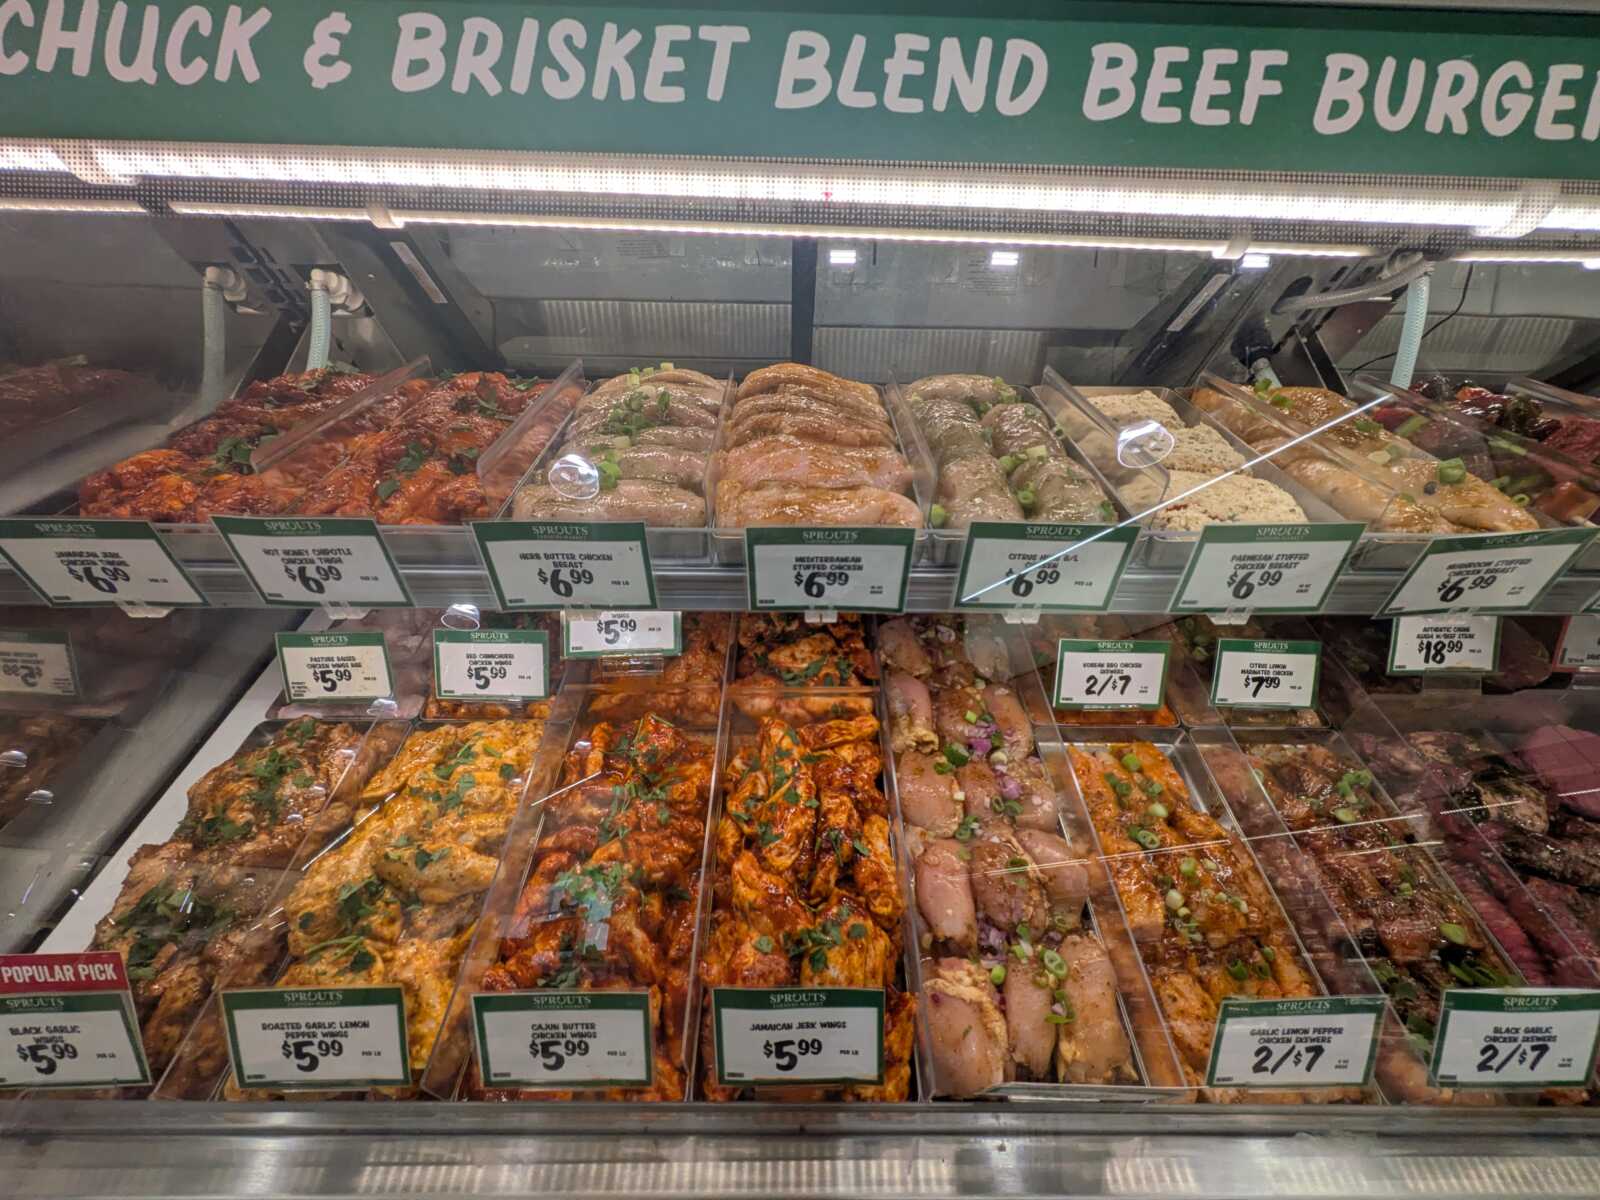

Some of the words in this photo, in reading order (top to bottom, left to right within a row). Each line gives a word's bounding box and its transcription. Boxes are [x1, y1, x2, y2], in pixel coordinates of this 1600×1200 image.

[0, 0, 273, 86] CHUCK
[303, 11, 352, 89] &
[391, 11, 750, 103] BRISKET
[774, 29, 1049, 117] BLEND
[1081, 41, 1290, 126] BEEF
[1311, 52, 1600, 143] BURGE
[263, 521, 321, 531] SPROUTS
[531, 525, 588, 536] SPROUTS
[802, 530, 858, 541] SPROUTS
[1025, 526, 1082, 537] SPROUTS
[1256, 527, 1311, 537] SPROUTS
[262, 548, 280, 556] HOT
[282, 548, 310, 556] HONEY
[311, 548, 352, 556] CHIPOTLE
[1008, 552, 1037, 561] CITRUS
[281, 557, 315, 565] CHICKEN
[519, 553, 542, 561] HERB
[543, 553, 577, 561] BUTTER
[578, 553, 613, 561] CHICKEN
[1230, 554, 1274, 562] PARMESAN
[1275, 553, 1310, 561] STUFFED
[552, 561, 584, 569] BREAST
[1233, 562, 1266, 570] CHICKEN
[1448, 568, 1482, 577] CHICKEN
[1483, 567, 1517, 575] BREAST
[470, 632, 509, 640] SPROUTS
[1097, 641, 1134, 649] SPROUTS
[1253, 641, 1288, 649] SPROUTS
[1085, 674, 1132, 696] 2/$7
[1, 964, 75, 983] POPULAR
[78, 963, 117, 981] PICK
[284, 991, 343, 1001] SPROUTS
[533, 996, 591, 1005] SPROUTS
[770, 993, 826, 1003] SPROUTS
[6, 999, 65, 1008] SPROUTS
[1276, 1001, 1330, 1010] SPROUTS
[1503, 997, 1558, 1006] SPROUTS
[262, 1022, 302, 1031] ROASTED
[305, 1022, 336, 1030] GARLIC
[340, 1020, 370, 1028] LEMON
[531, 1023, 559, 1031] CAJUN
[750, 1023, 793, 1031] JAMAICAN
[820, 1021, 846, 1029] WINGS
[9, 1027, 43, 1036] BLACK
[45, 1025, 81, 1034] GARLIC
[285, 1031, 318, 1039] PEPPER
[1250, 1028, 1279, 1036] GARLIC
[1312, 1027, 1344, 1035] PEPPER
[1484, 1035, 1518, 1043] CHICKEN
[1252, 1045, 1325, 1075] 2/$7
[1477, 1044, 1550, 1074] 2/$7
